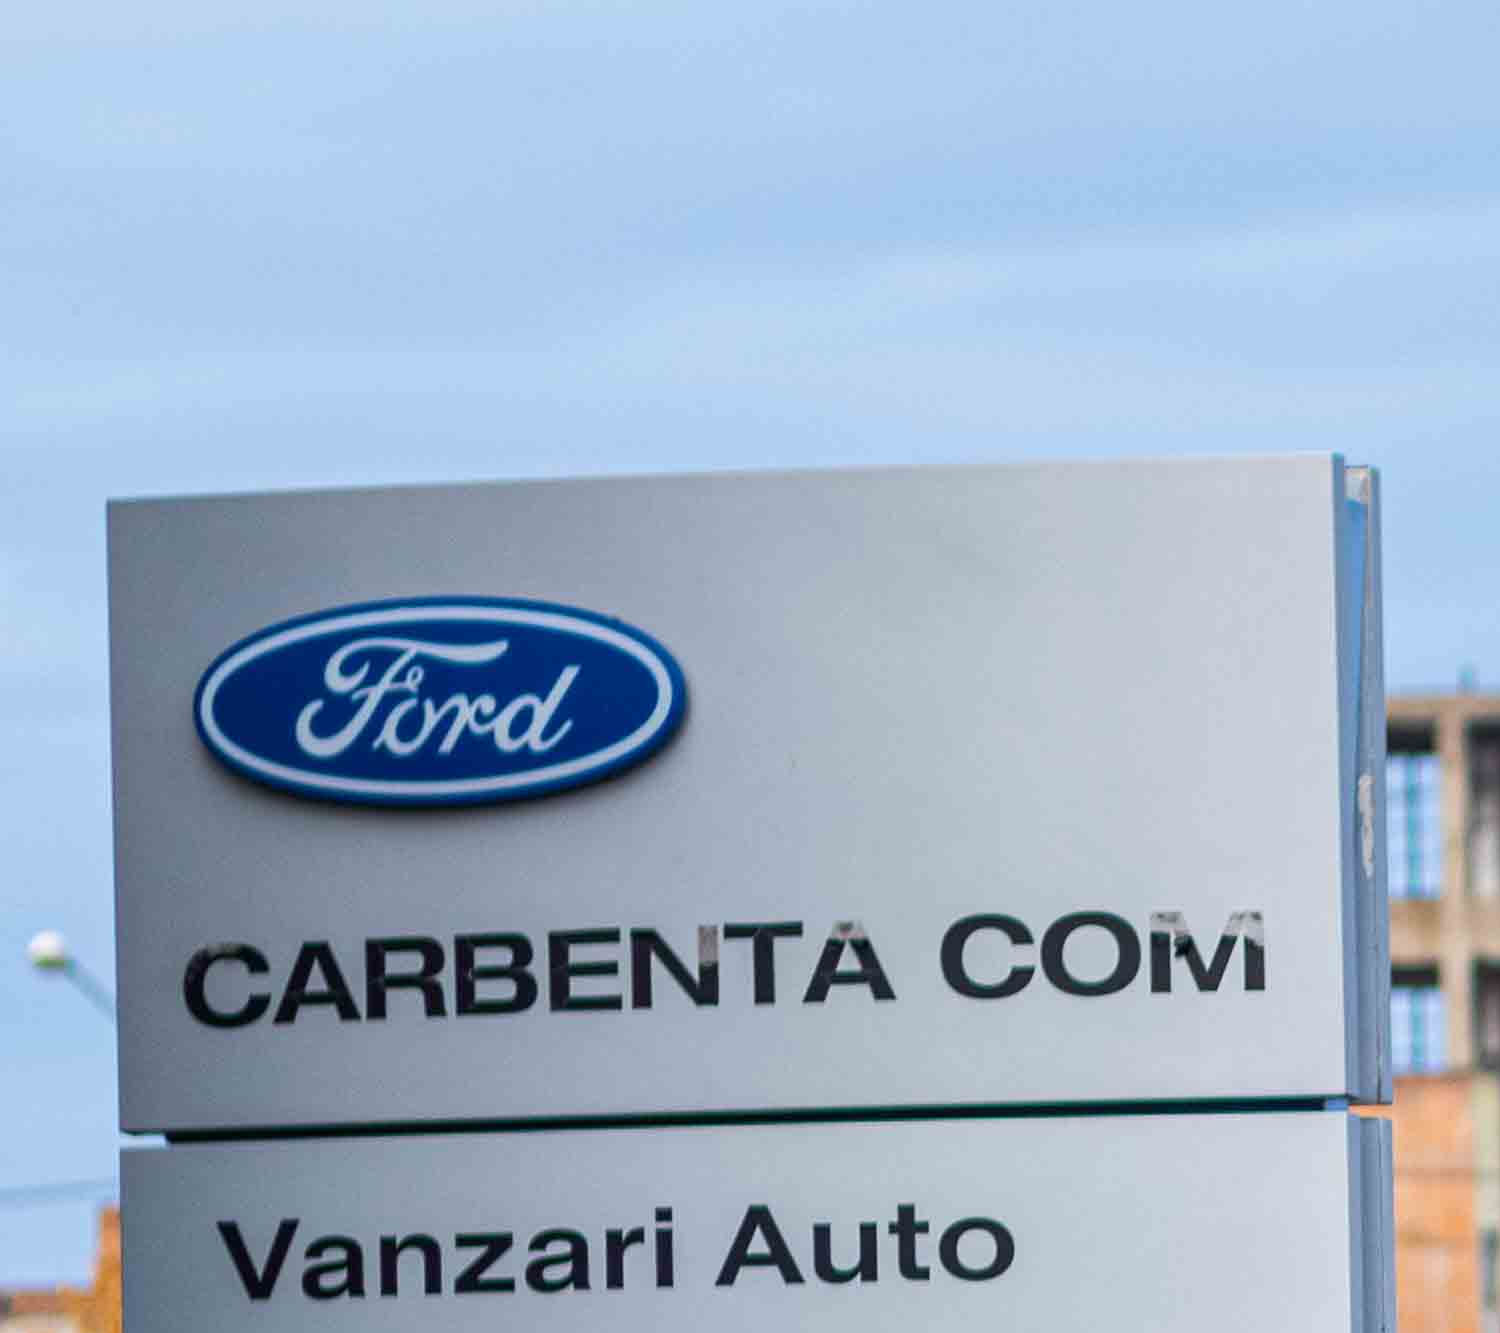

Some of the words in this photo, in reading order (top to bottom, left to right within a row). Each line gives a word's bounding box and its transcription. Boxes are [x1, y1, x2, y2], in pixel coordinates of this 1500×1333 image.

[295, 636, 581, 757] Ford
[181, 920, 896, 1031] CARBENTA
[940, 911, 1266, 999] COM
[215, 1206, 675, 1303] Vanzari
[715, 1203, 1016, 1288] Auto
